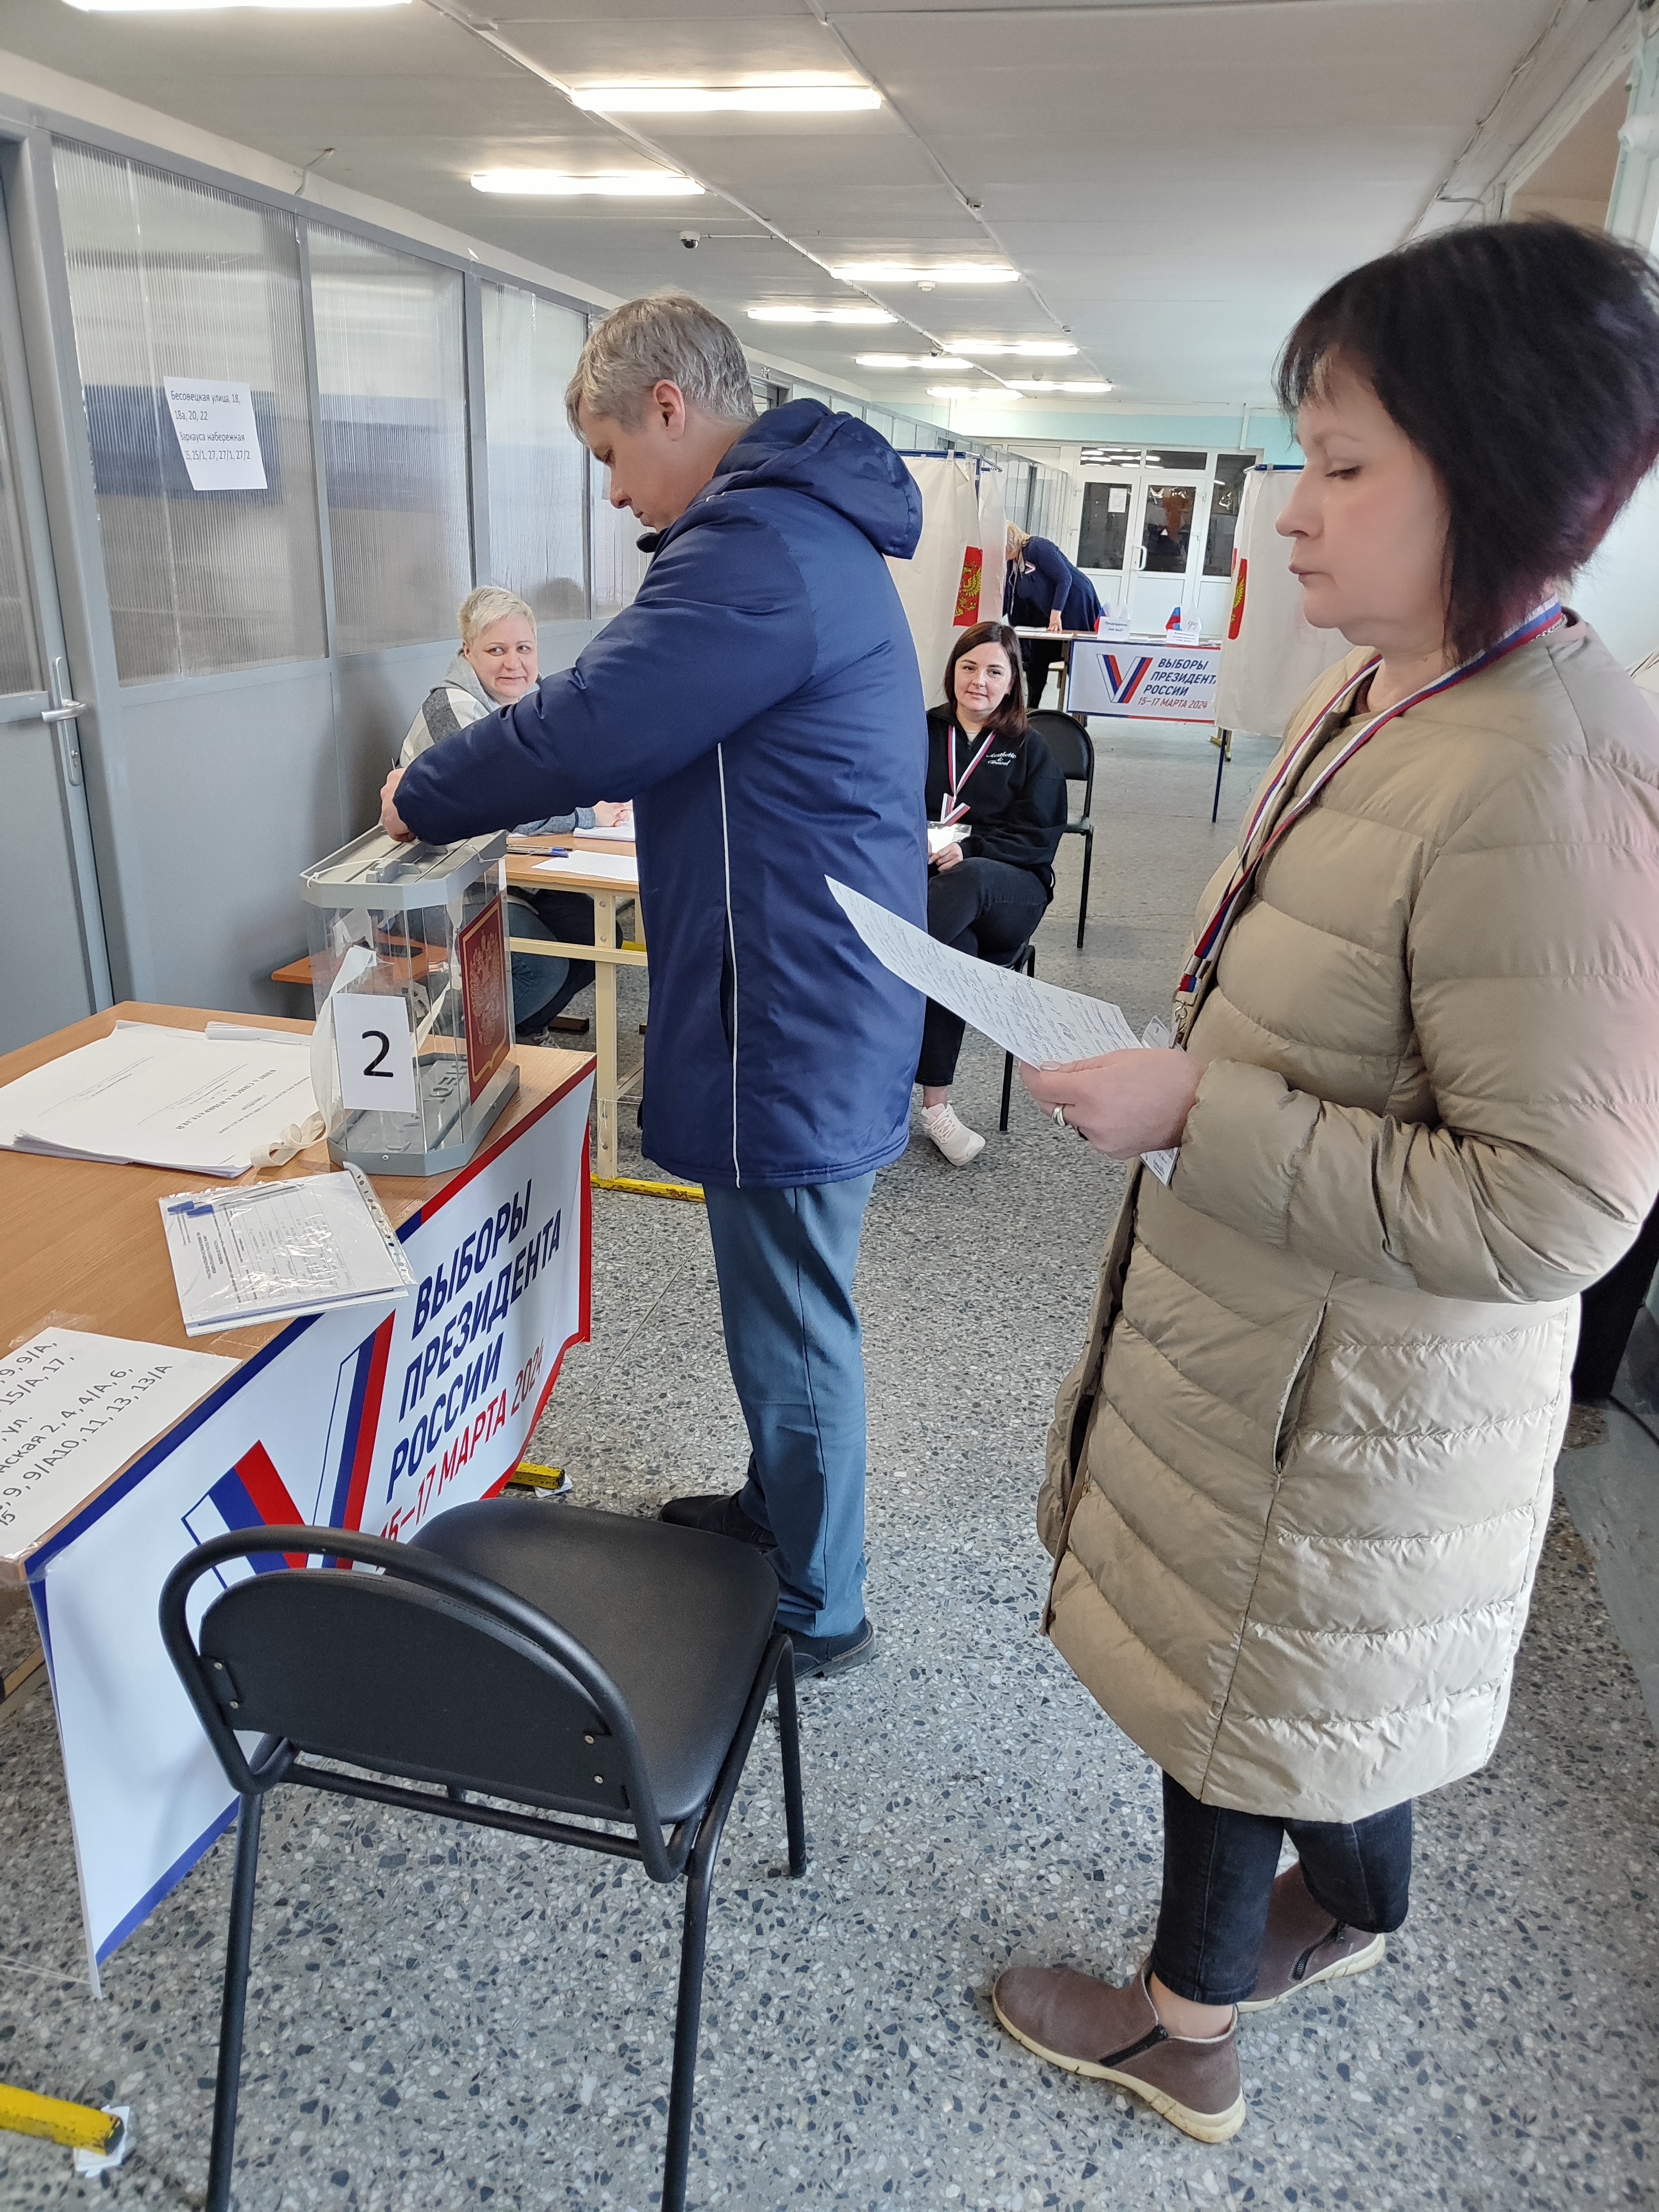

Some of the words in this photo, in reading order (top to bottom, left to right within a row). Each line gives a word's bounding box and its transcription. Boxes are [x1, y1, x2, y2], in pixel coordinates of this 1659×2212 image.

[171, 390, 210, 403] Бесовецкая
[232, 394, 241, 404] 18,
[175, 410, 187, 421] 18а,
[188, 410, 198, 421] 20,
[200, 411, 208, 420] 22
[179, 431, 206, 443] Варкауса
[207, 431, 245, 443] набережная
[208, 450, 218, 461] 27,
[218, 449, 235, 461] 27/1,
[236, 449, 251, 461] 27/2
[1157, 658, 1209, 670] ВЫБОРЫ
[1143, 685, 1189, 696] РОССИИ
[1160, 698, 1188, 708] МАРТА
[1188, 700, 1208, 709] 2024
[361, 1030, 394, 1078] 2
[411, 1178, 532, 1341] ВЫБОРЫ
[399, 1208, 561, 1423] ПРЕЗИДЕНТА
[131, 1366, 173, 1391] 13/А
[386, 1331, 504, 1505] РОССИИ
[437, 1387, 507, 1498] МАРТА
[510, 1337, 544, 1417] 2024
[1, 1417, 33, 1434] ул.
